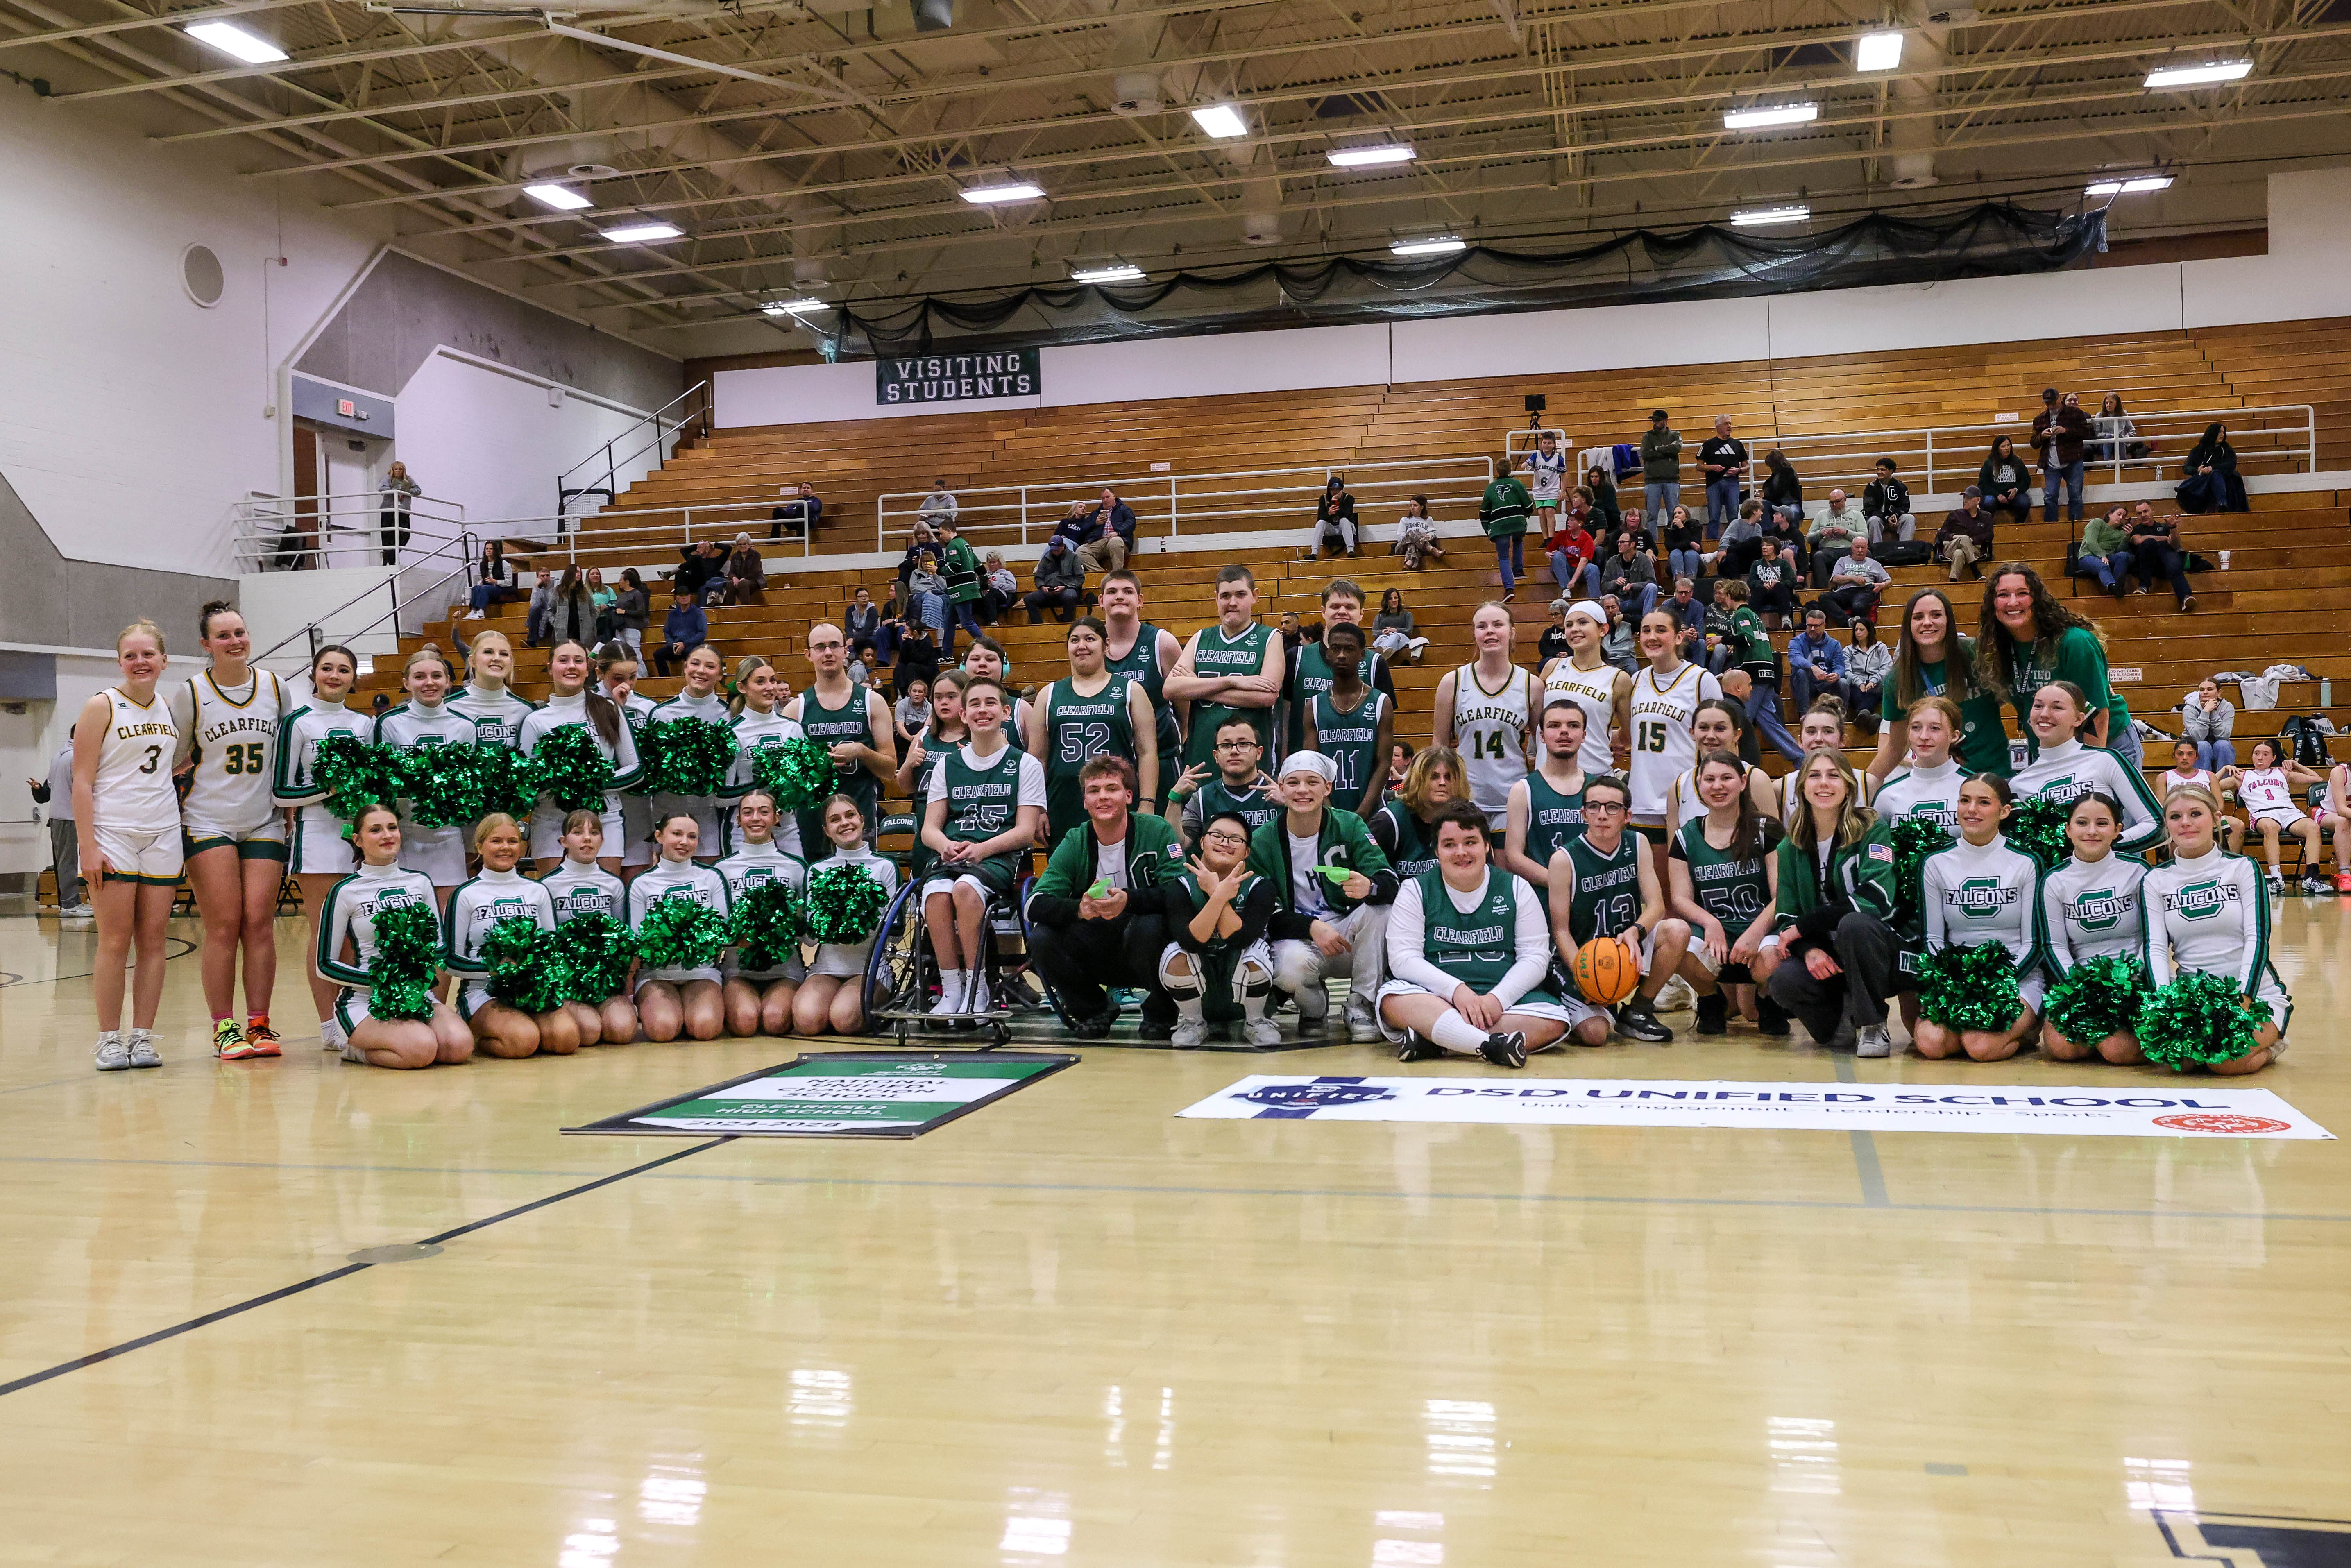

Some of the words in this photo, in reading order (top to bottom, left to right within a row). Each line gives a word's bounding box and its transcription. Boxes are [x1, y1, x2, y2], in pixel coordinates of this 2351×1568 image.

[896, 354, 1020, 379] VISITING
[886, 374, 1030, 401] STUDENTS
[342, 401, 352, 413] EXIT
[1540, 477, 1548, 487] 6
[1195, 650, 1257, 664] CLEARFIELD
[1546, 680, 1607, 702] CLEARFIELD
[1056, 704, 1115, 716] CLEARFIELD
[1455, 706, 1525, 731] CLEARFIELD
[1632, 702, 1686, 722] CLEARFIELD
[807, 721, 863, 737] CLEARFIELD
[1318, 728, 1373, 743] CLEARFIELD
[1638, 721, 1667, 753] 15
[1060, 723, 1110, 762] 52
[1473, 730, 1505, 761] 14
[139, 745, 162, 774] 3
[224, 742, 264, 775] 35
[1333, 749, 1360, 789] 11
[952, 783, 1011, 800] CLEARFIELD
[2248, 779, 2284, 793] FALCONS
[2265, 789, 2274, 800] 1
[883, 818, 913, 827] FALCONS
[955, 803, 1008, 832] 45
[555, 896, 611, 911] FALCONS
[1701, 883, 1765, 921] 50
[1944, 887, 2018, 906] FALCONS
[2162, 884, 2240, 911] FALCONS
[476, 904, 538, 920] FALCONS
[1593, 893, 1636, 939] 13
[2063, 895, 2134, 920] FALCONS
[1434, 925, 1503, 944] CLEARFIELD
[1425, 1088, 1568, 1097] DSD
[1586, 1090, 1875, 1102] UNIFIED
[1894, 1095, 2231, 1108] SCHOOL
